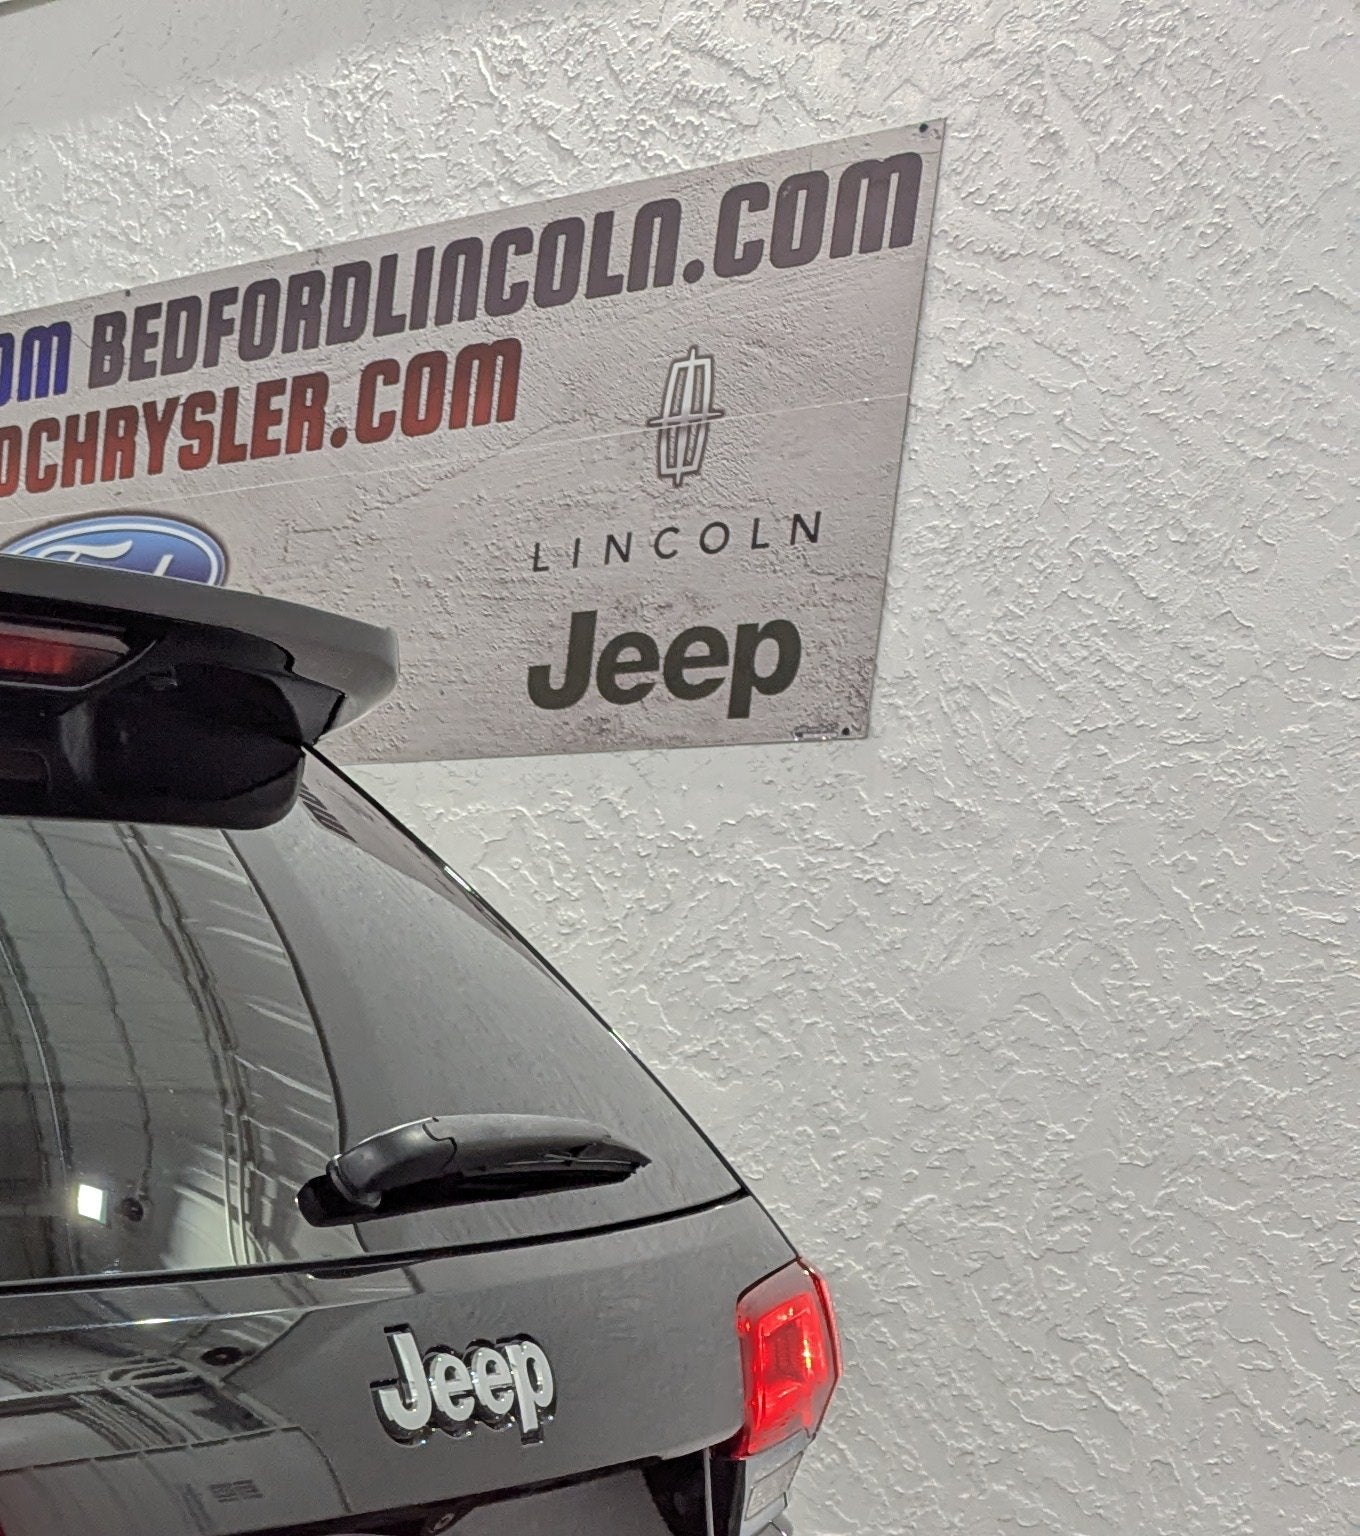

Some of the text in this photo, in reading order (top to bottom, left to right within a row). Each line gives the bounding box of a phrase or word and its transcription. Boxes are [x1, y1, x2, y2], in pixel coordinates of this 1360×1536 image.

[88, 151, 923, 389] BEDFORDLINCOLN.COM
[532, 511, 822, 573] LINCOLN
[527, 609, 802, 719] Jeep
[371, 1323, 556, 1445] Jeep
